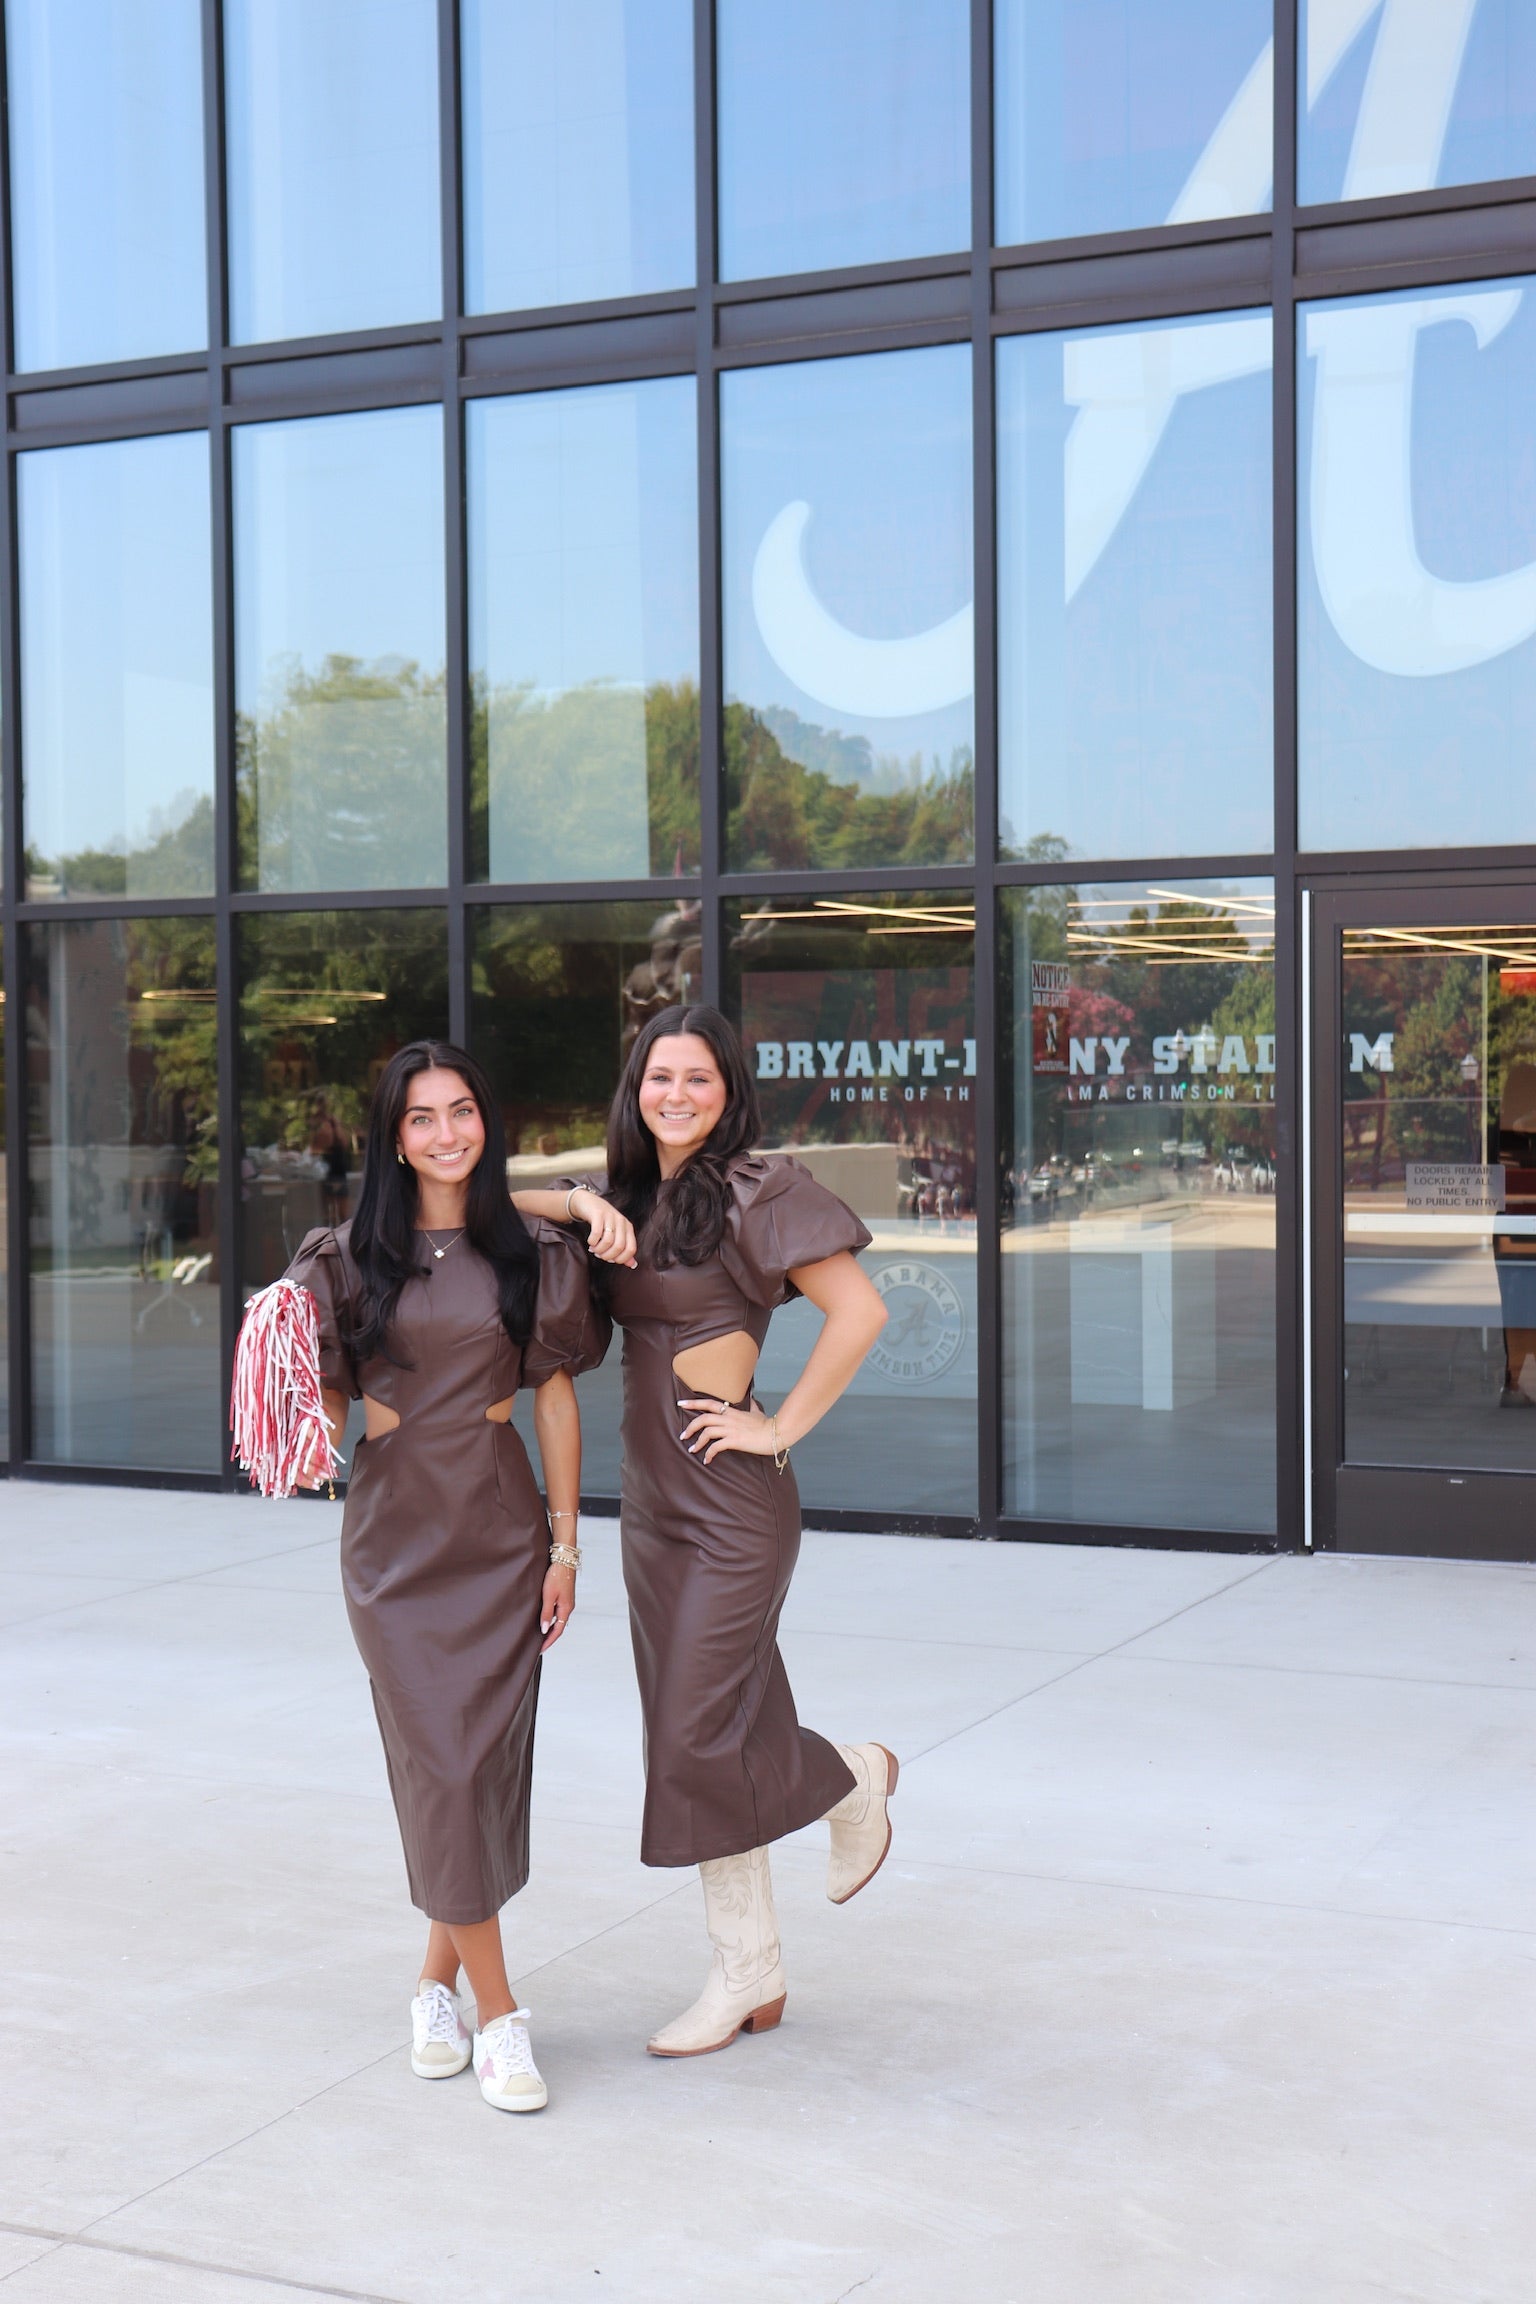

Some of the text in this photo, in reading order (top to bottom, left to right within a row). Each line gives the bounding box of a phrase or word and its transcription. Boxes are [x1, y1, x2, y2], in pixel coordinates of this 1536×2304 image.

[1032, 963, 1069, 990] NOTICE
[1152, 1032, 1394, 1074] STADM
[830, 1087, 888, 1102] HOME
[904, 1087, 928, 1101] OF
[944, 1086, 969, 1101] TH
[1126, 1083, 1235, 1100] CRIMSON
[1253, 1084, 1275, 1100] TI
[1413, 1176, 1493, 1186] LOCKED AT ALL
[1414, 1166, 1493, 1175] DOORS REMAIN
[1407, 1197, 1498, 1207] NO PUBLIC ENTRY
[883, 1267, 956, 1315] ABAMA
[870, 1347, 924, 1376] IMSON
